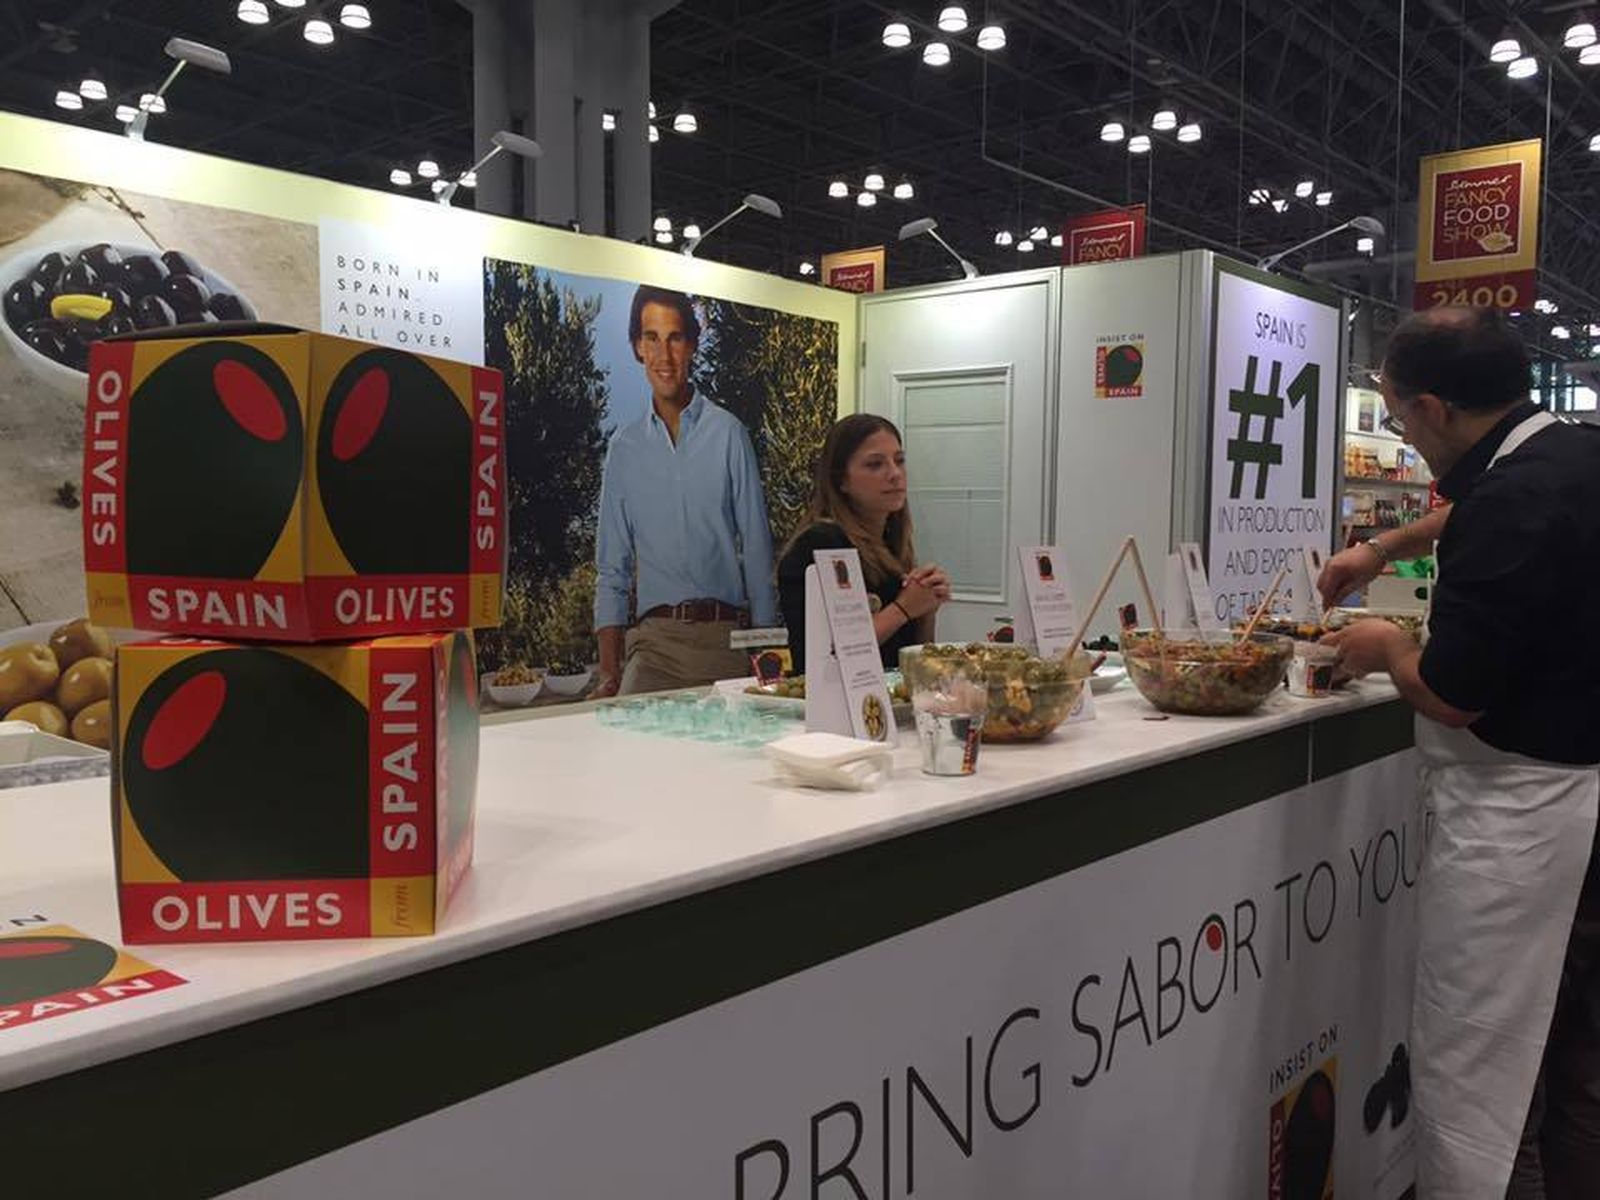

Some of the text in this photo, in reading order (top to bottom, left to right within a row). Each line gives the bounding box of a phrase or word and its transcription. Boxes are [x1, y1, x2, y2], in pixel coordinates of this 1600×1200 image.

[1445, 185, 1512, 208] FANCY
[1444, 203, 1511, 226] FOOD
[1443, 220, 1509, 243] SHOW
[337, 255, 439, 283] BORN IN
[1432, 284, 1518, 308] 2400
[338, 301, 442, 326] ADMIRED
[338, 323, 452, 348] ALL OVER
[1255, 311, 1307, 350] SPAIN IS
[1227, 355, 1320, 500] #1
[92, 369, 122, 546] OLIVES
[477, 391, 498, 551] SPAIN
[1218, 506, 1325, 533] IN PRODUCTION
[1224, 549, 1258, 576] AND
[148, 588, 288, 630] SPAIN
[335, 587, 455, 625] OLIVES
[1215, 593, 1236, 621] OF
[382, 673, 418, 852] SPAIN
[152, 892, 342, 932] OLIVES
[1072, 898, 1261, 1087] SABOR
[1274, 861, 1336, 960] TO
[1269, 1024, 1339, 1095] INSIST ON
